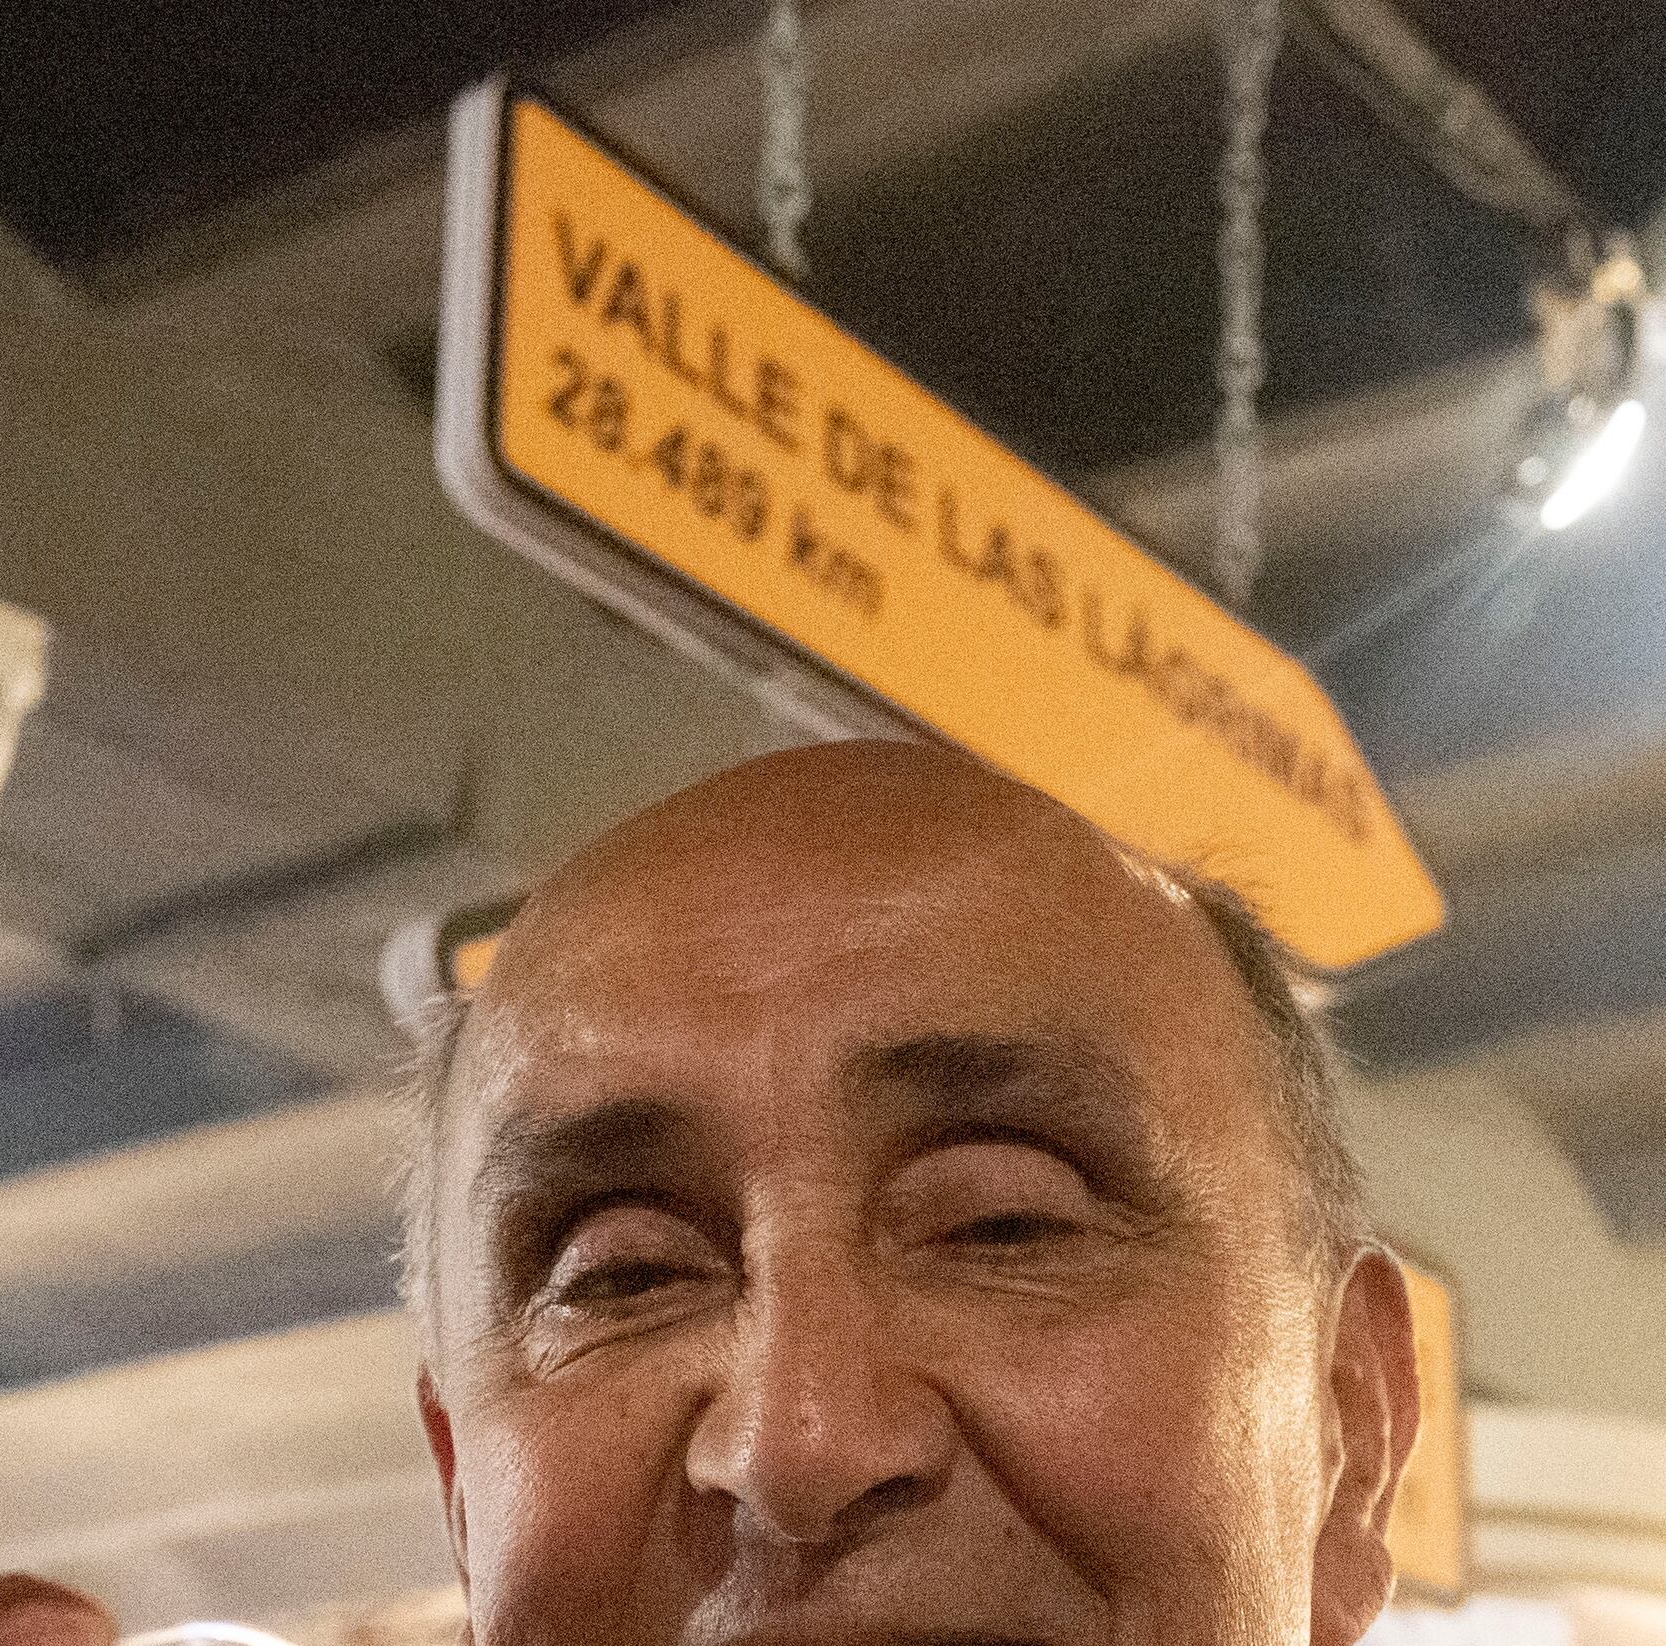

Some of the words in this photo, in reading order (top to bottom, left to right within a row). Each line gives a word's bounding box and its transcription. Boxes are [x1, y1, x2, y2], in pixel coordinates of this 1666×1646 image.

[550, 206, 803, 458] VALLE
[823, 405, 921, 537] DE
[936, 480, 1066, 633] LAS
[786, 508, 887, 622] km
